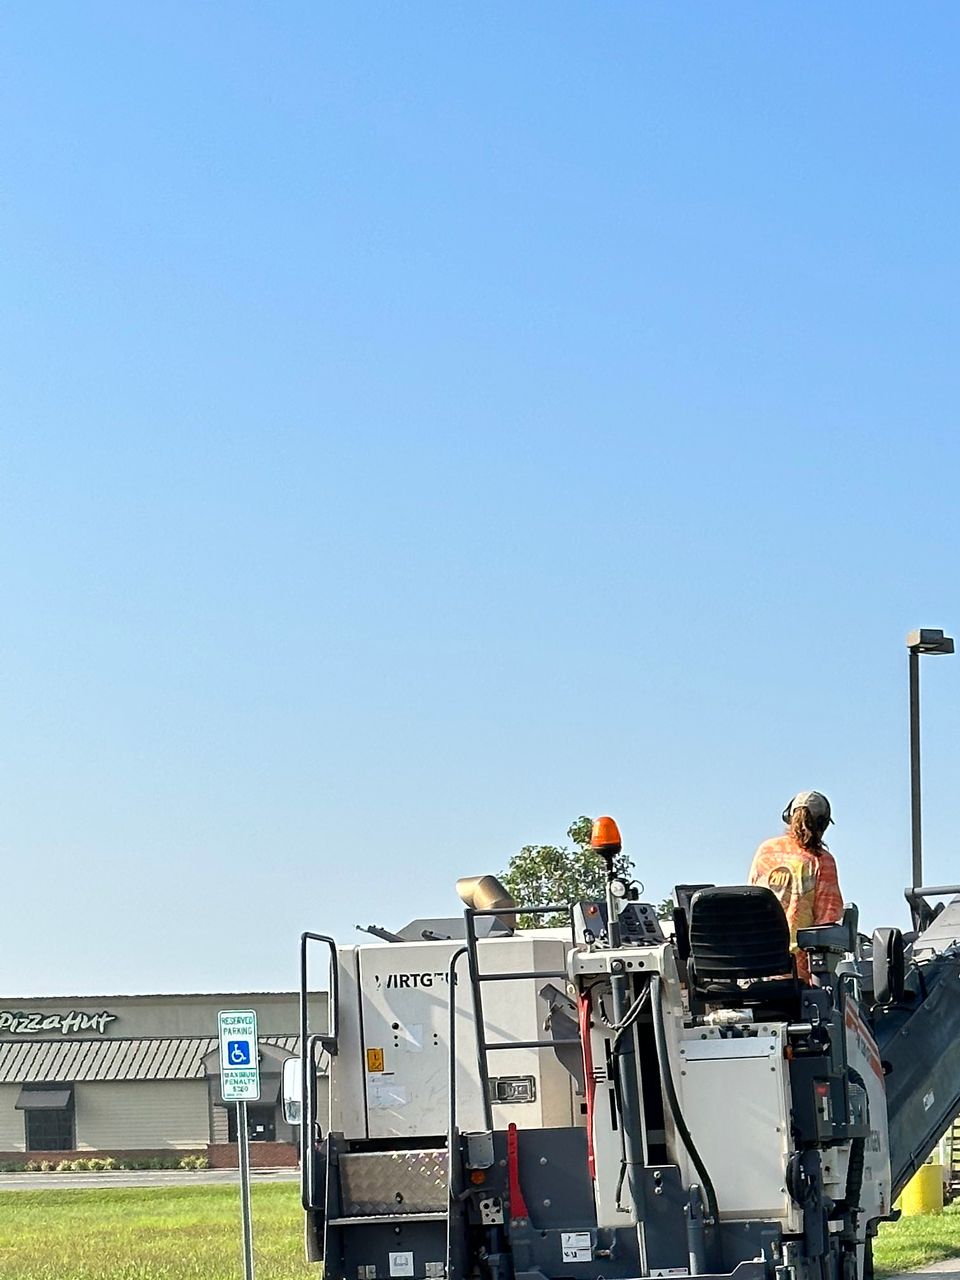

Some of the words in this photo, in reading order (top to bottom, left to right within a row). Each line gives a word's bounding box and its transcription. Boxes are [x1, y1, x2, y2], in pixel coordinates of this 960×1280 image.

[0, 1012, 61, 1033] Pizza
[60, 1011, 116, 1034] Hut
[221, 1016, 254, 1025] RESERVED
[223, 1027, 253, 1036] PARKING
